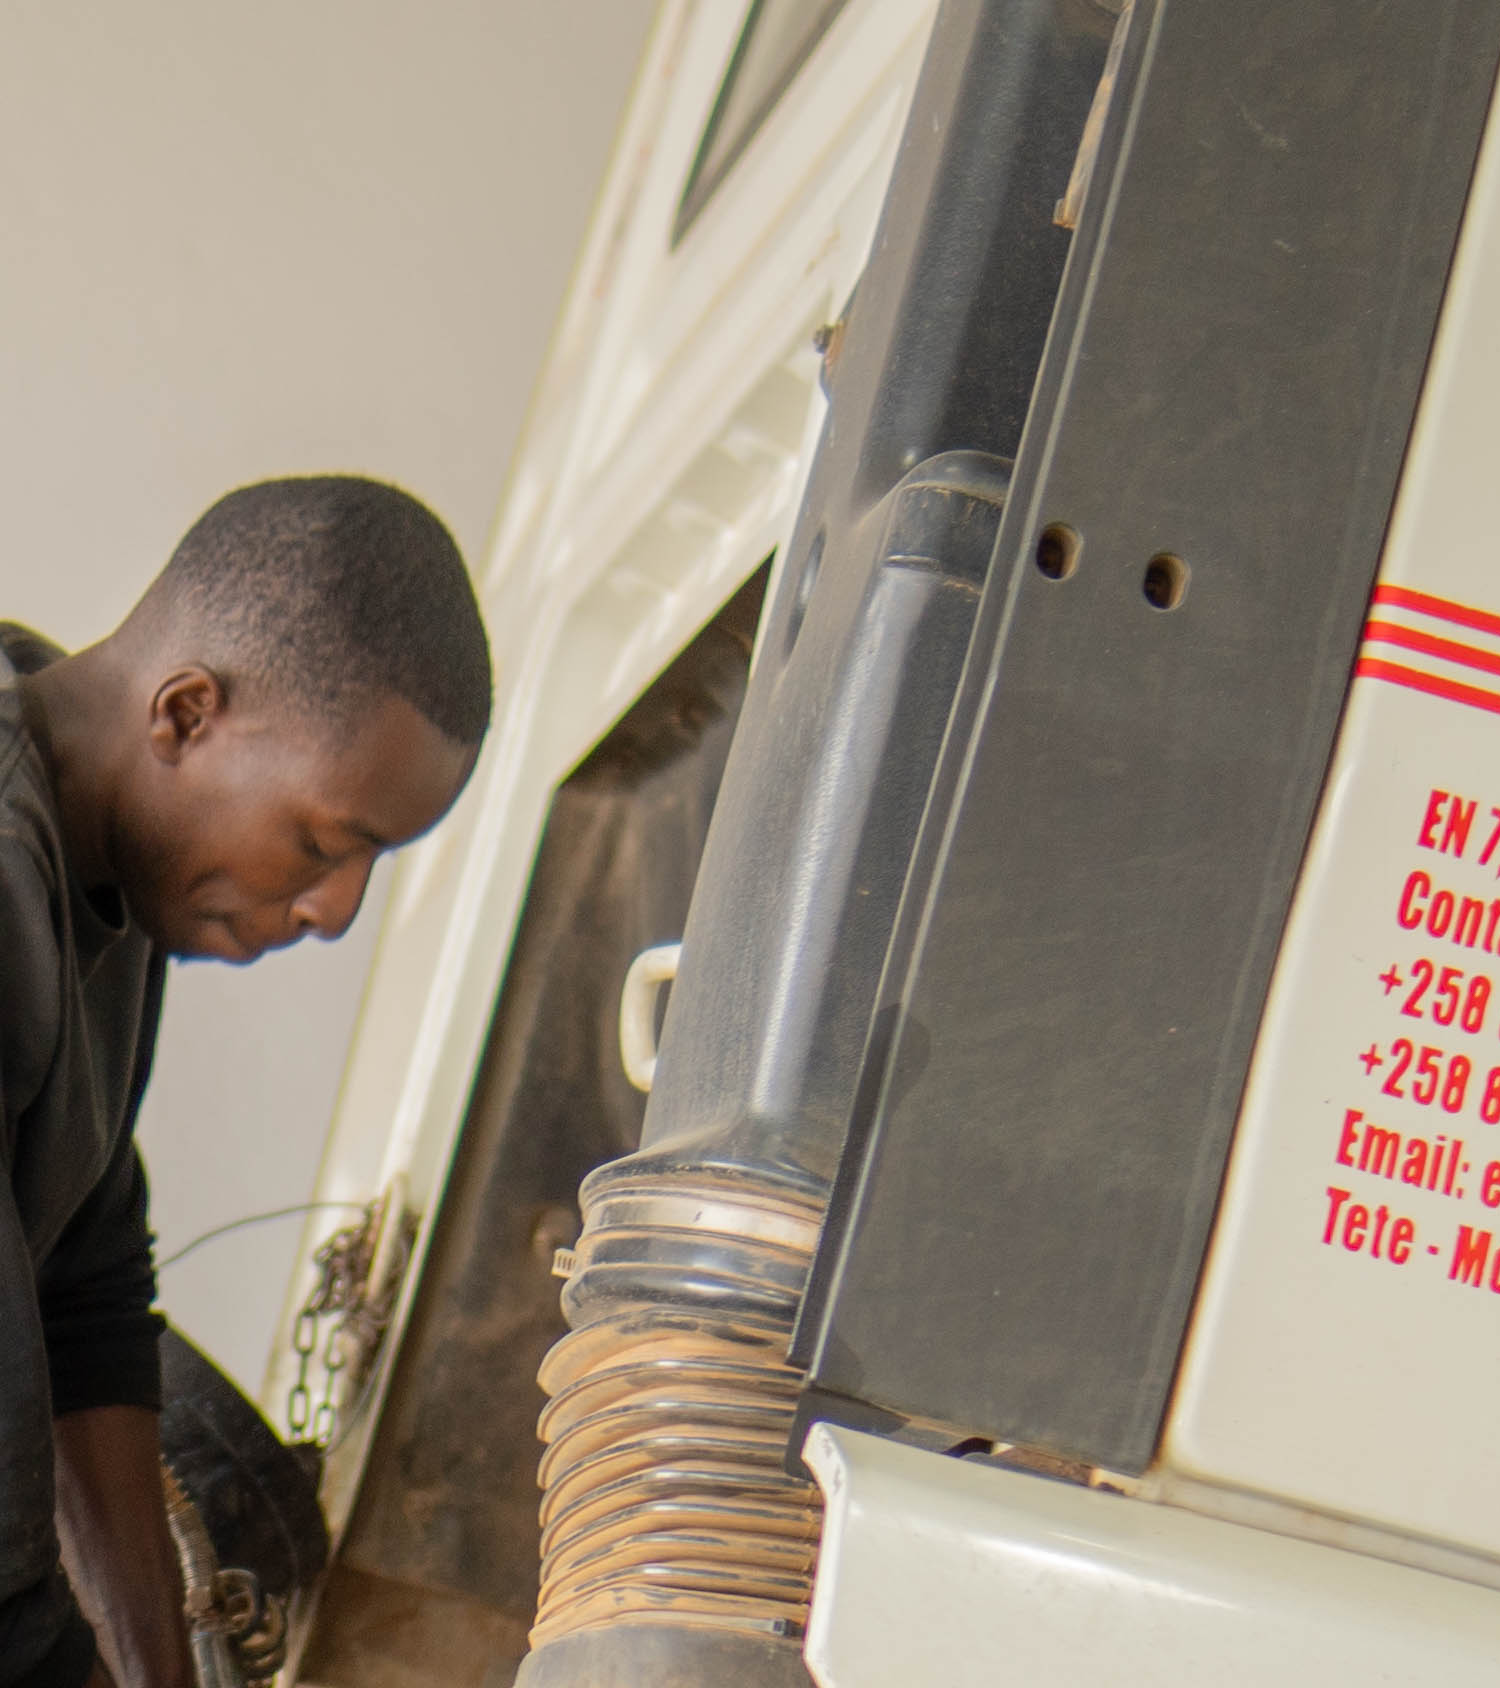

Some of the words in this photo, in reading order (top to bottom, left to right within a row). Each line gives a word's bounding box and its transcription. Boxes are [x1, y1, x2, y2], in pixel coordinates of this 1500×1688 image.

[1416, 789, 1479, 859] EN
[1379, 957, 1492, 1035] +258
[1358, 1037, 1472, 1114] +258
[1335, 1108, 1471, 1200] Email:
[1322, 1186, 1415, 1265] Tete
